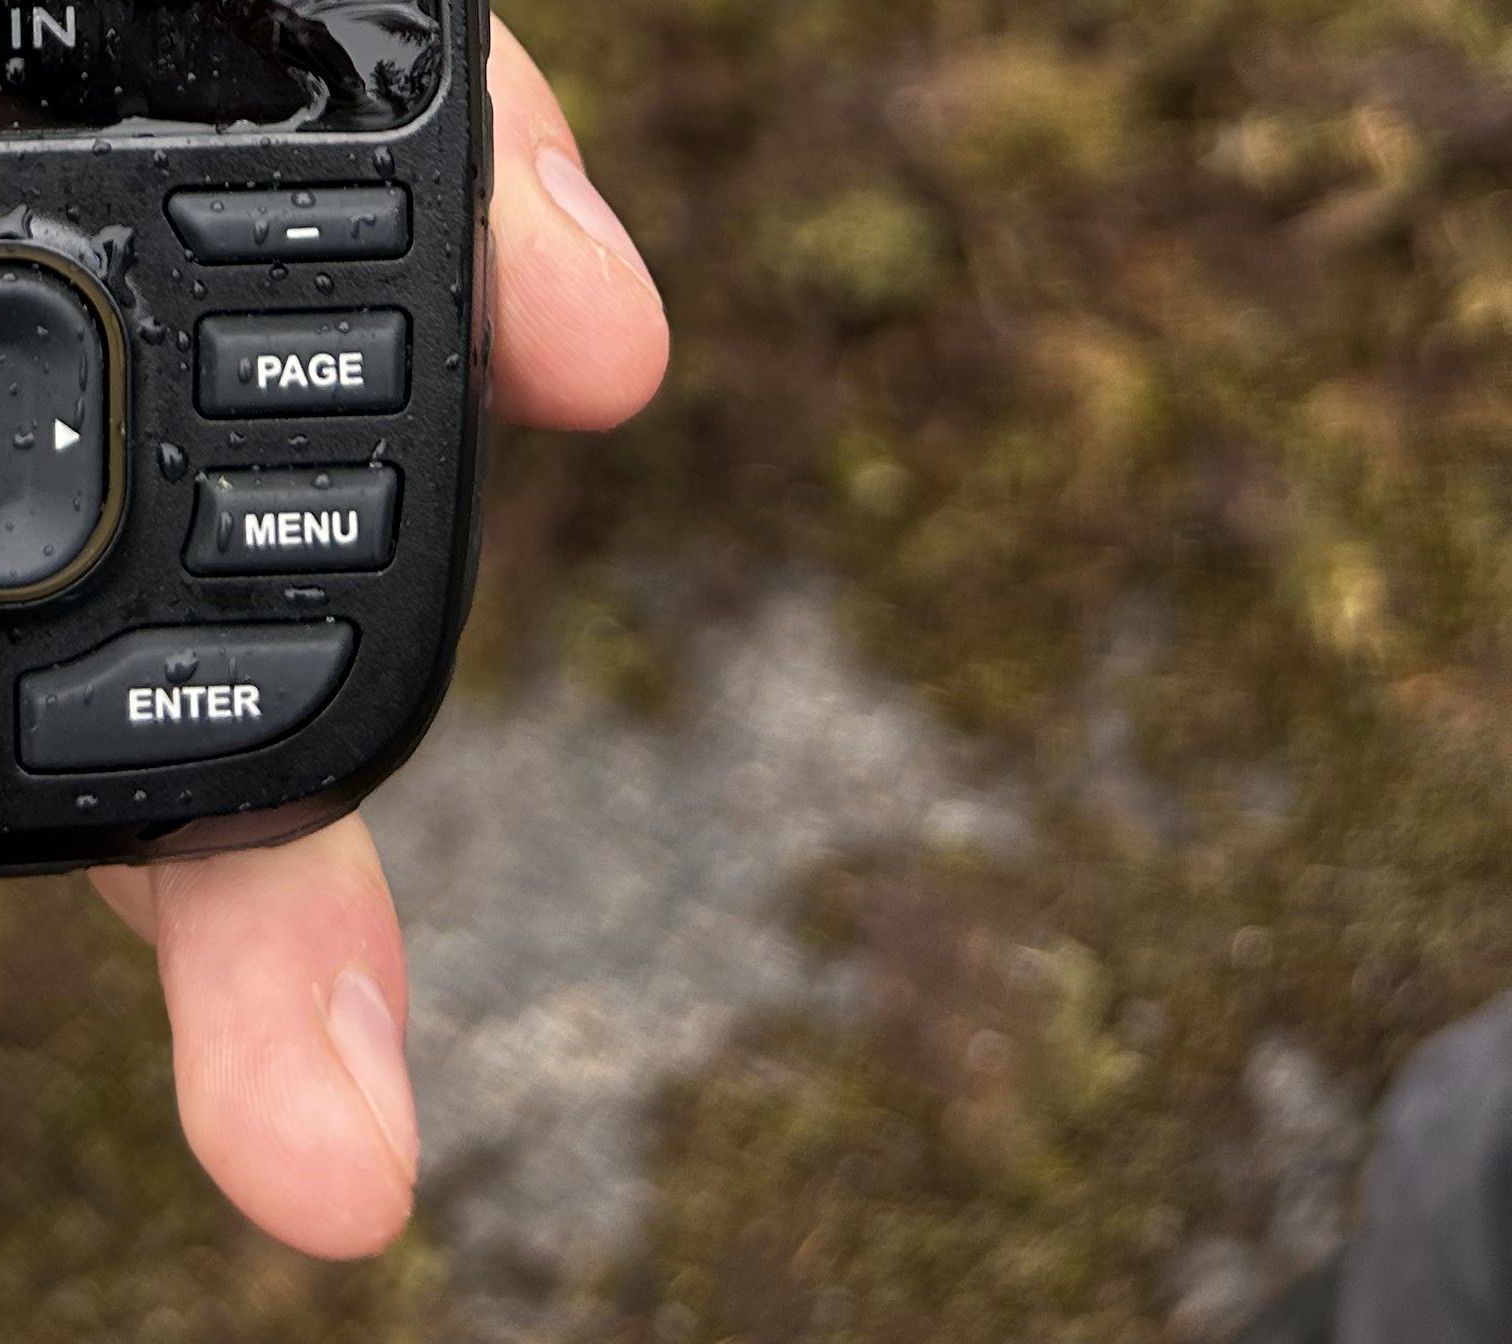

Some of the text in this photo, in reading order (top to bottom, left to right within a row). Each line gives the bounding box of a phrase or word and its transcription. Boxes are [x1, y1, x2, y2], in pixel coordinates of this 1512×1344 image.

[256, 353, 364, 388] PAGE
[244, 511, 359, 548] MENU
[128, 685, 261, 721] ENTER
